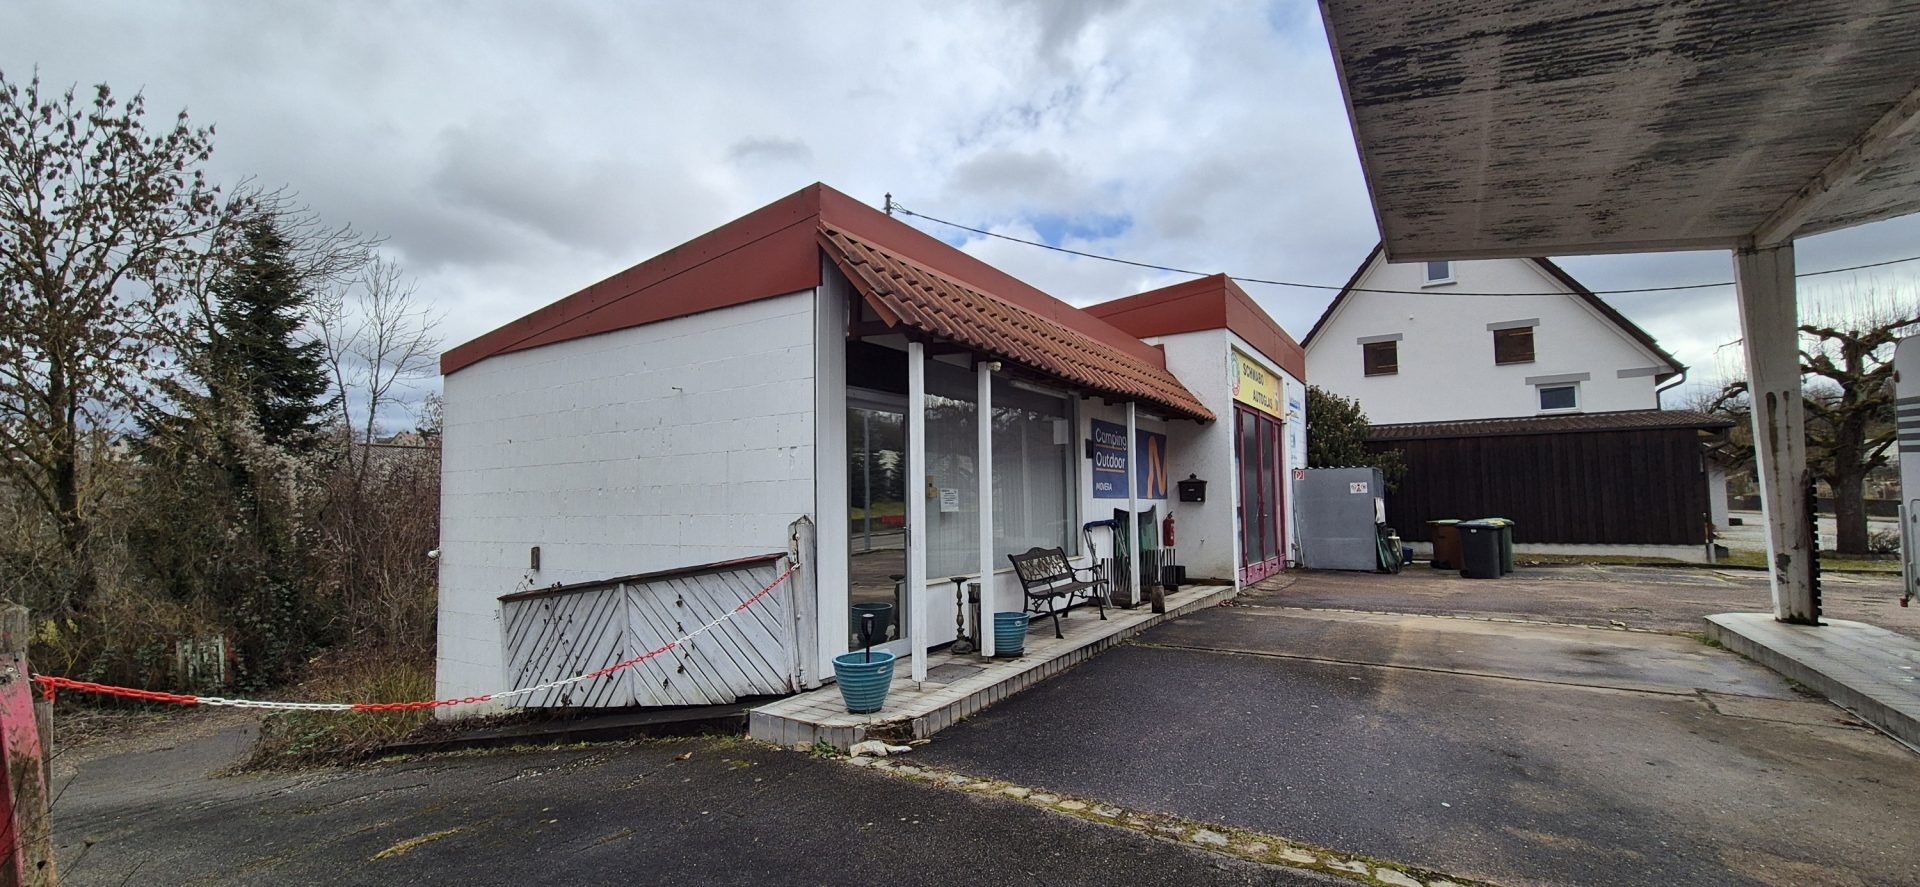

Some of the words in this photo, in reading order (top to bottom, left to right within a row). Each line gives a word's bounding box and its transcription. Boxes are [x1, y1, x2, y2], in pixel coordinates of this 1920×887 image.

[1252, 389, 1273, 410] AUTOGLAS
[1095, 427, 1127, 450] Camping
[1095, 451, 1126, 469] Outdoor
